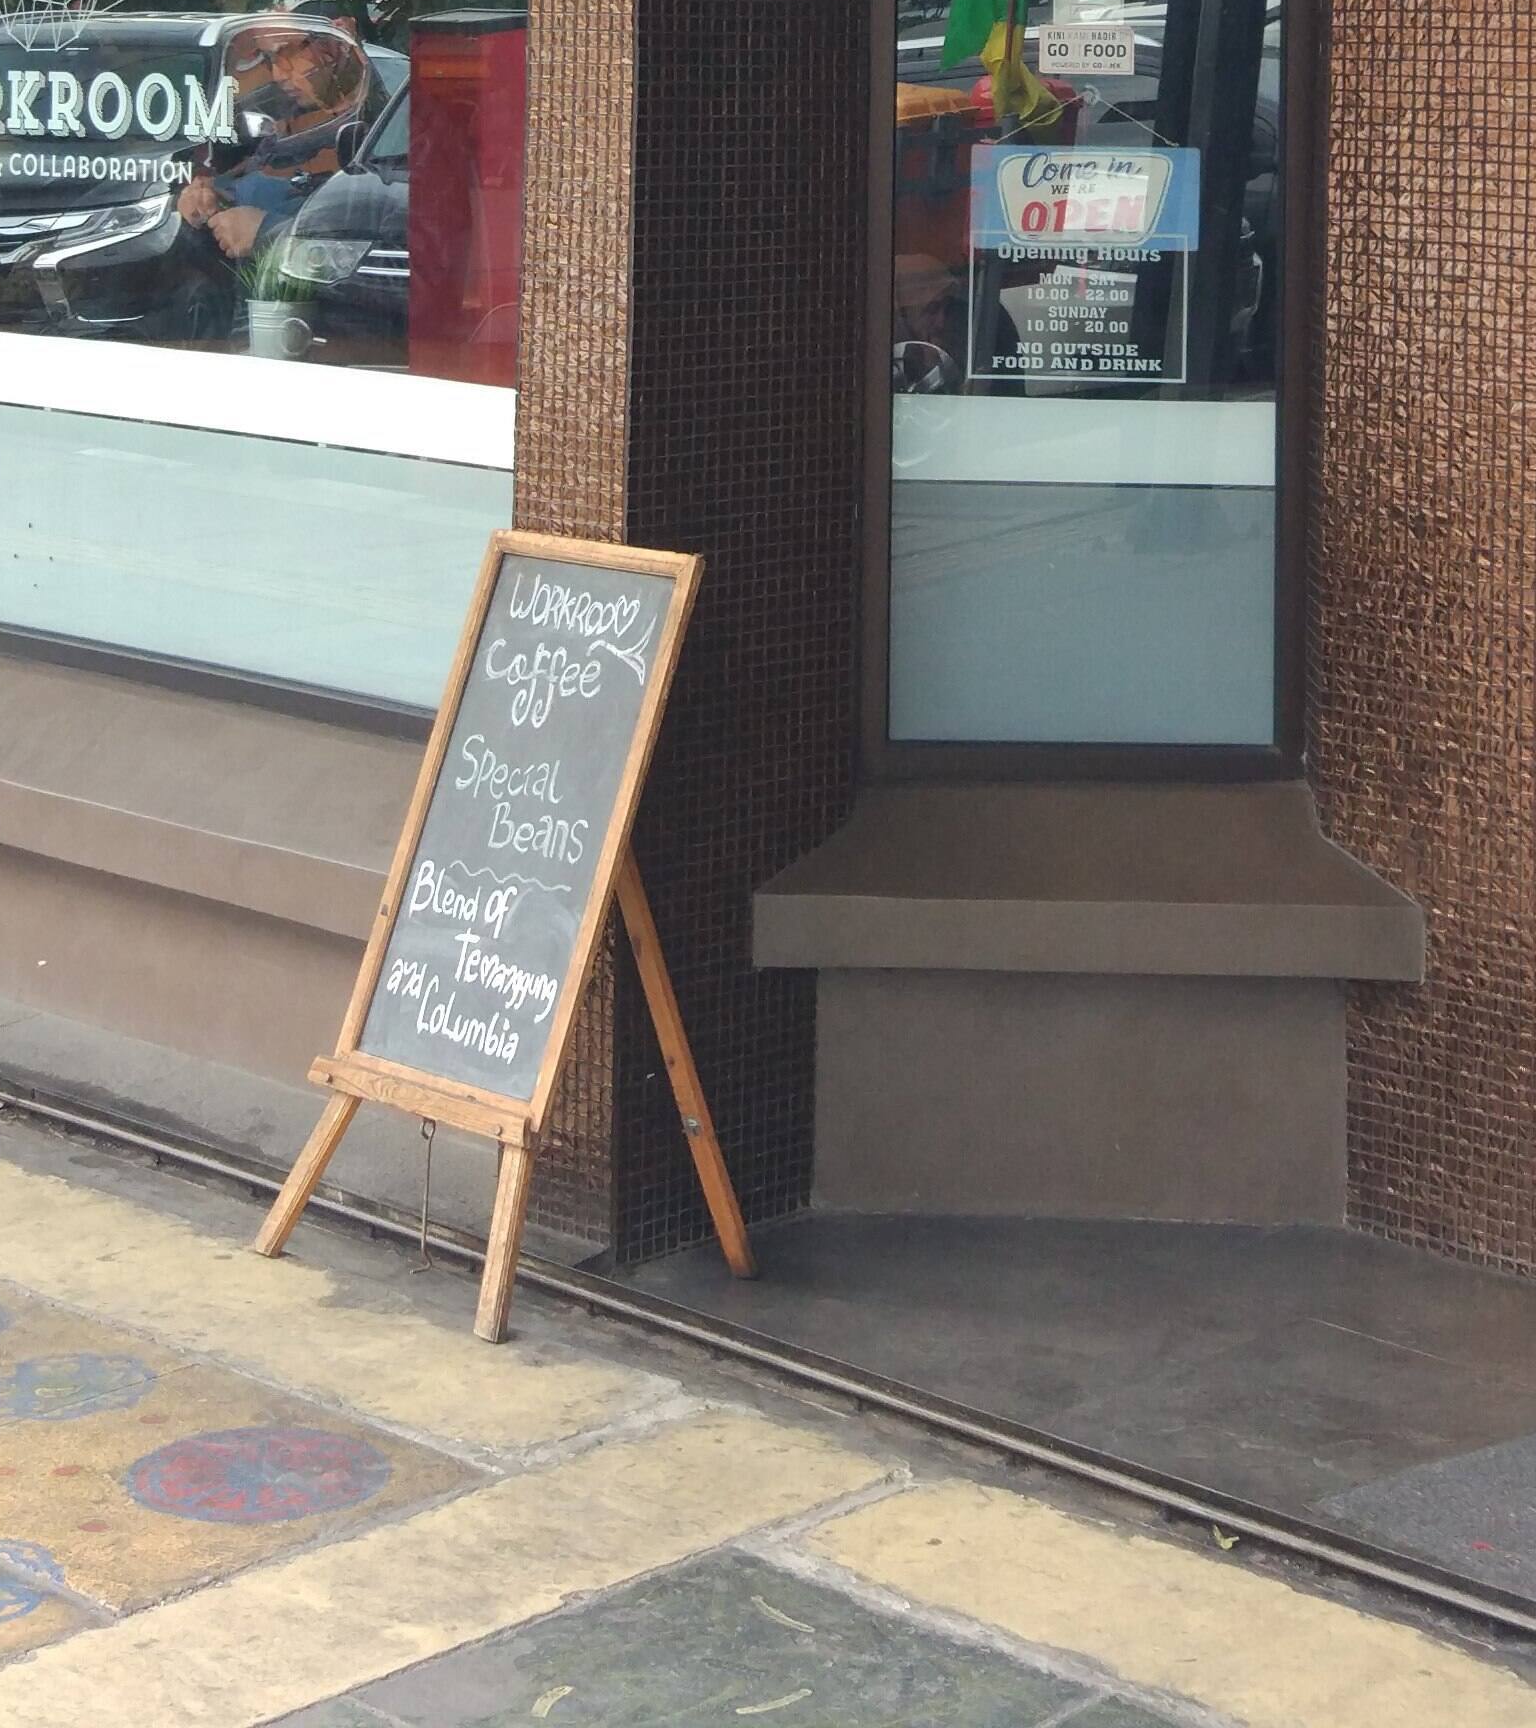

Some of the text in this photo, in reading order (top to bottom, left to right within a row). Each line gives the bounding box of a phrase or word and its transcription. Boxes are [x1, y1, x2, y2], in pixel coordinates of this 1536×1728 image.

[1084, 44, 1127, 58] FOOD
[9, 152, 194, 185] COLLABORATION
[1021, 152, 1098, 188] Come
[1020, 195, 1146, 233] OPEN
[997, 242, 1162, 264] Opening Hours
[1039, 273, 1117, 286] MON SAT
[1027, 288, 1069, 300] 10.00
[1085, 289, 1129, 302] 22.00
[1047, 306, 1109, 319] SUNDAY
[1027, 319, 1069, 332] 10.00
[1084, 321, 1129, 333] 20.00
[1016, 342, 1139, 357] NO OUTSIDE
[992, 356, 1162, 371] FOOD AND DRINK
[484, 637, 603, 728] Coffee
[454, 734, 564, 804] Special
[487, 802, 590, 865] Beans
[409, 860, 518, 939] Blend of
